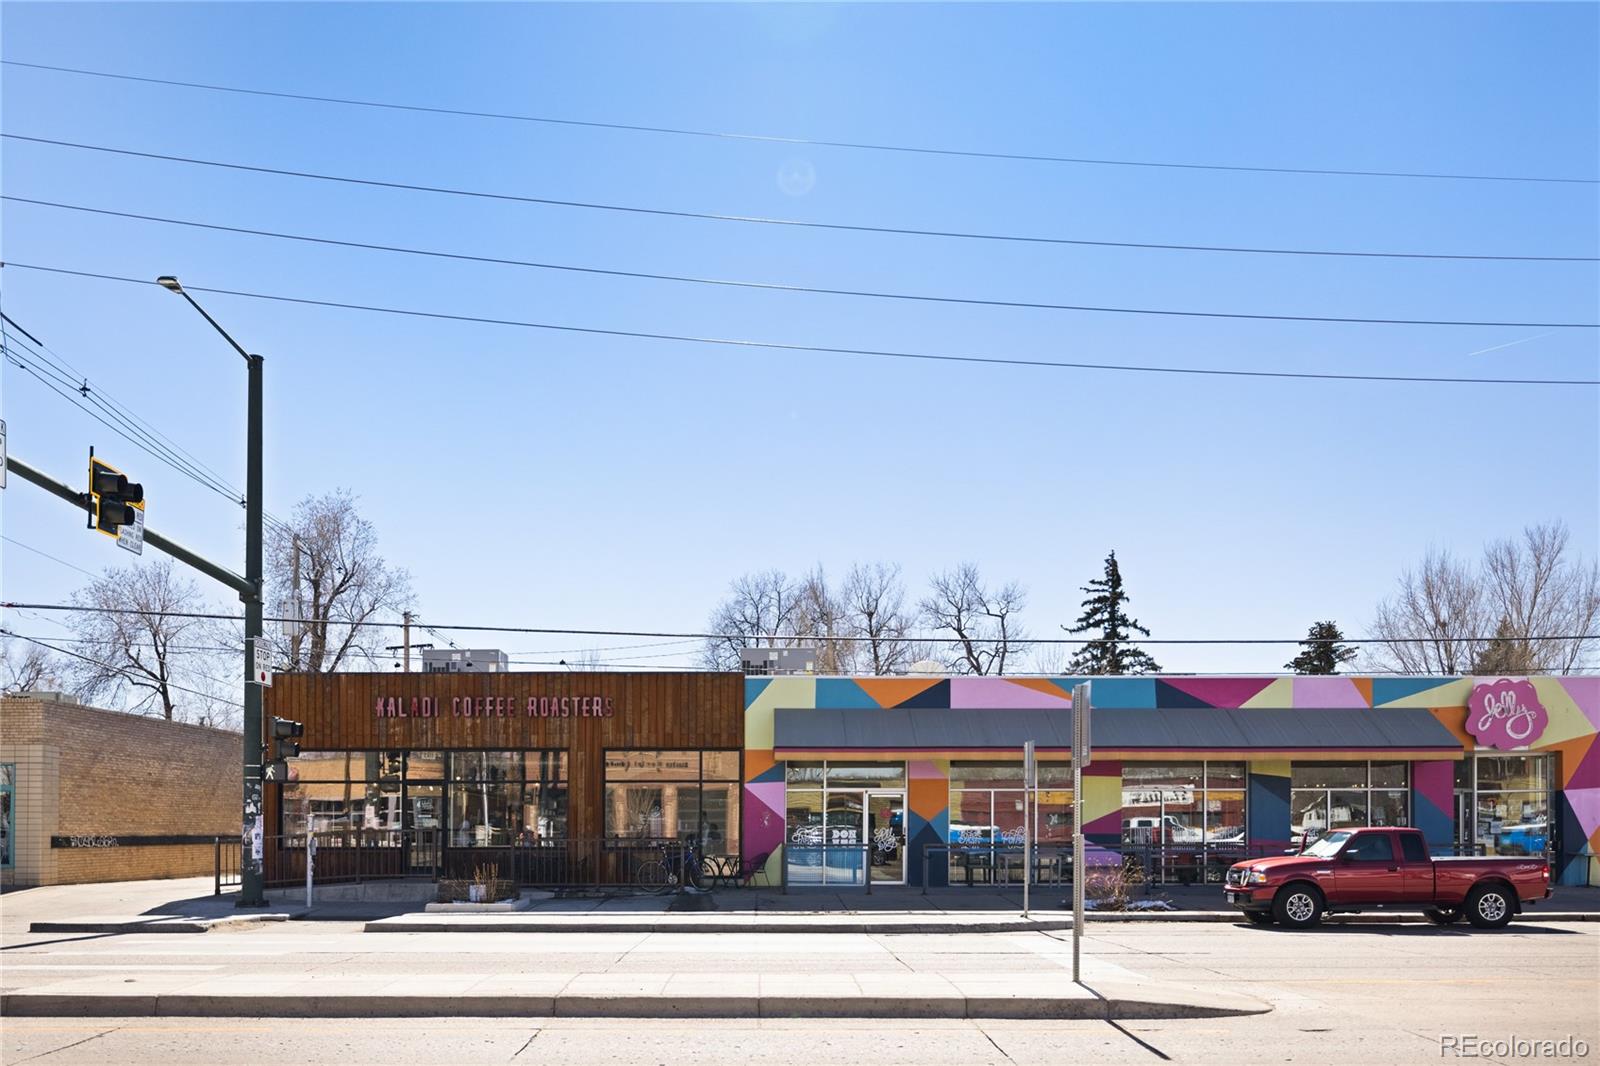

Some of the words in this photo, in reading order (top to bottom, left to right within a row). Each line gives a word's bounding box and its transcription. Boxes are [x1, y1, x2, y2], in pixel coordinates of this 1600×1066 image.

[256, 649, 270, 661] STOP
[375, 696, 439, 718] KALADI
[452, 696, 515, 718] COFFEE
[527, 696, 613, 718] ROASTERS
[1478, 690, 1537, 740] Jelly
